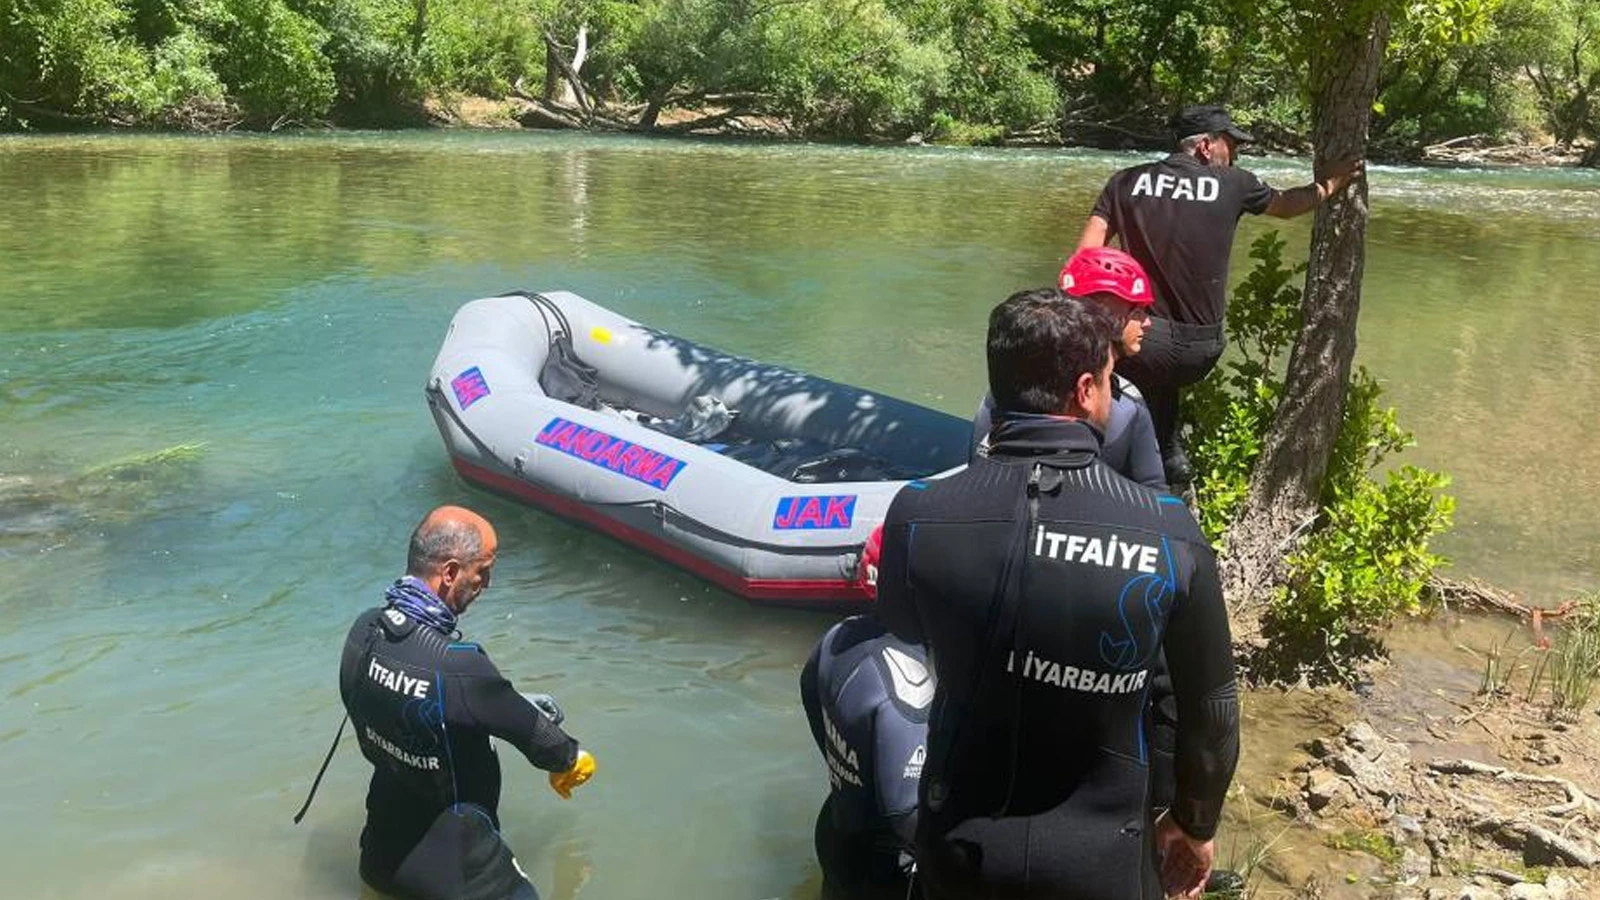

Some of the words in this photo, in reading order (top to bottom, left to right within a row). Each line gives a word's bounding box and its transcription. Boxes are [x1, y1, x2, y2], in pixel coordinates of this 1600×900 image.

[1131, 173, 1220, 201] AFAD
[537, 419, 679, 489] JANDARMA
[777, 496, 854, 528] JAK
[1035, 525, 1158, 573] İTFAİYE
[368, 657, 430, 699] İTFAİYE
